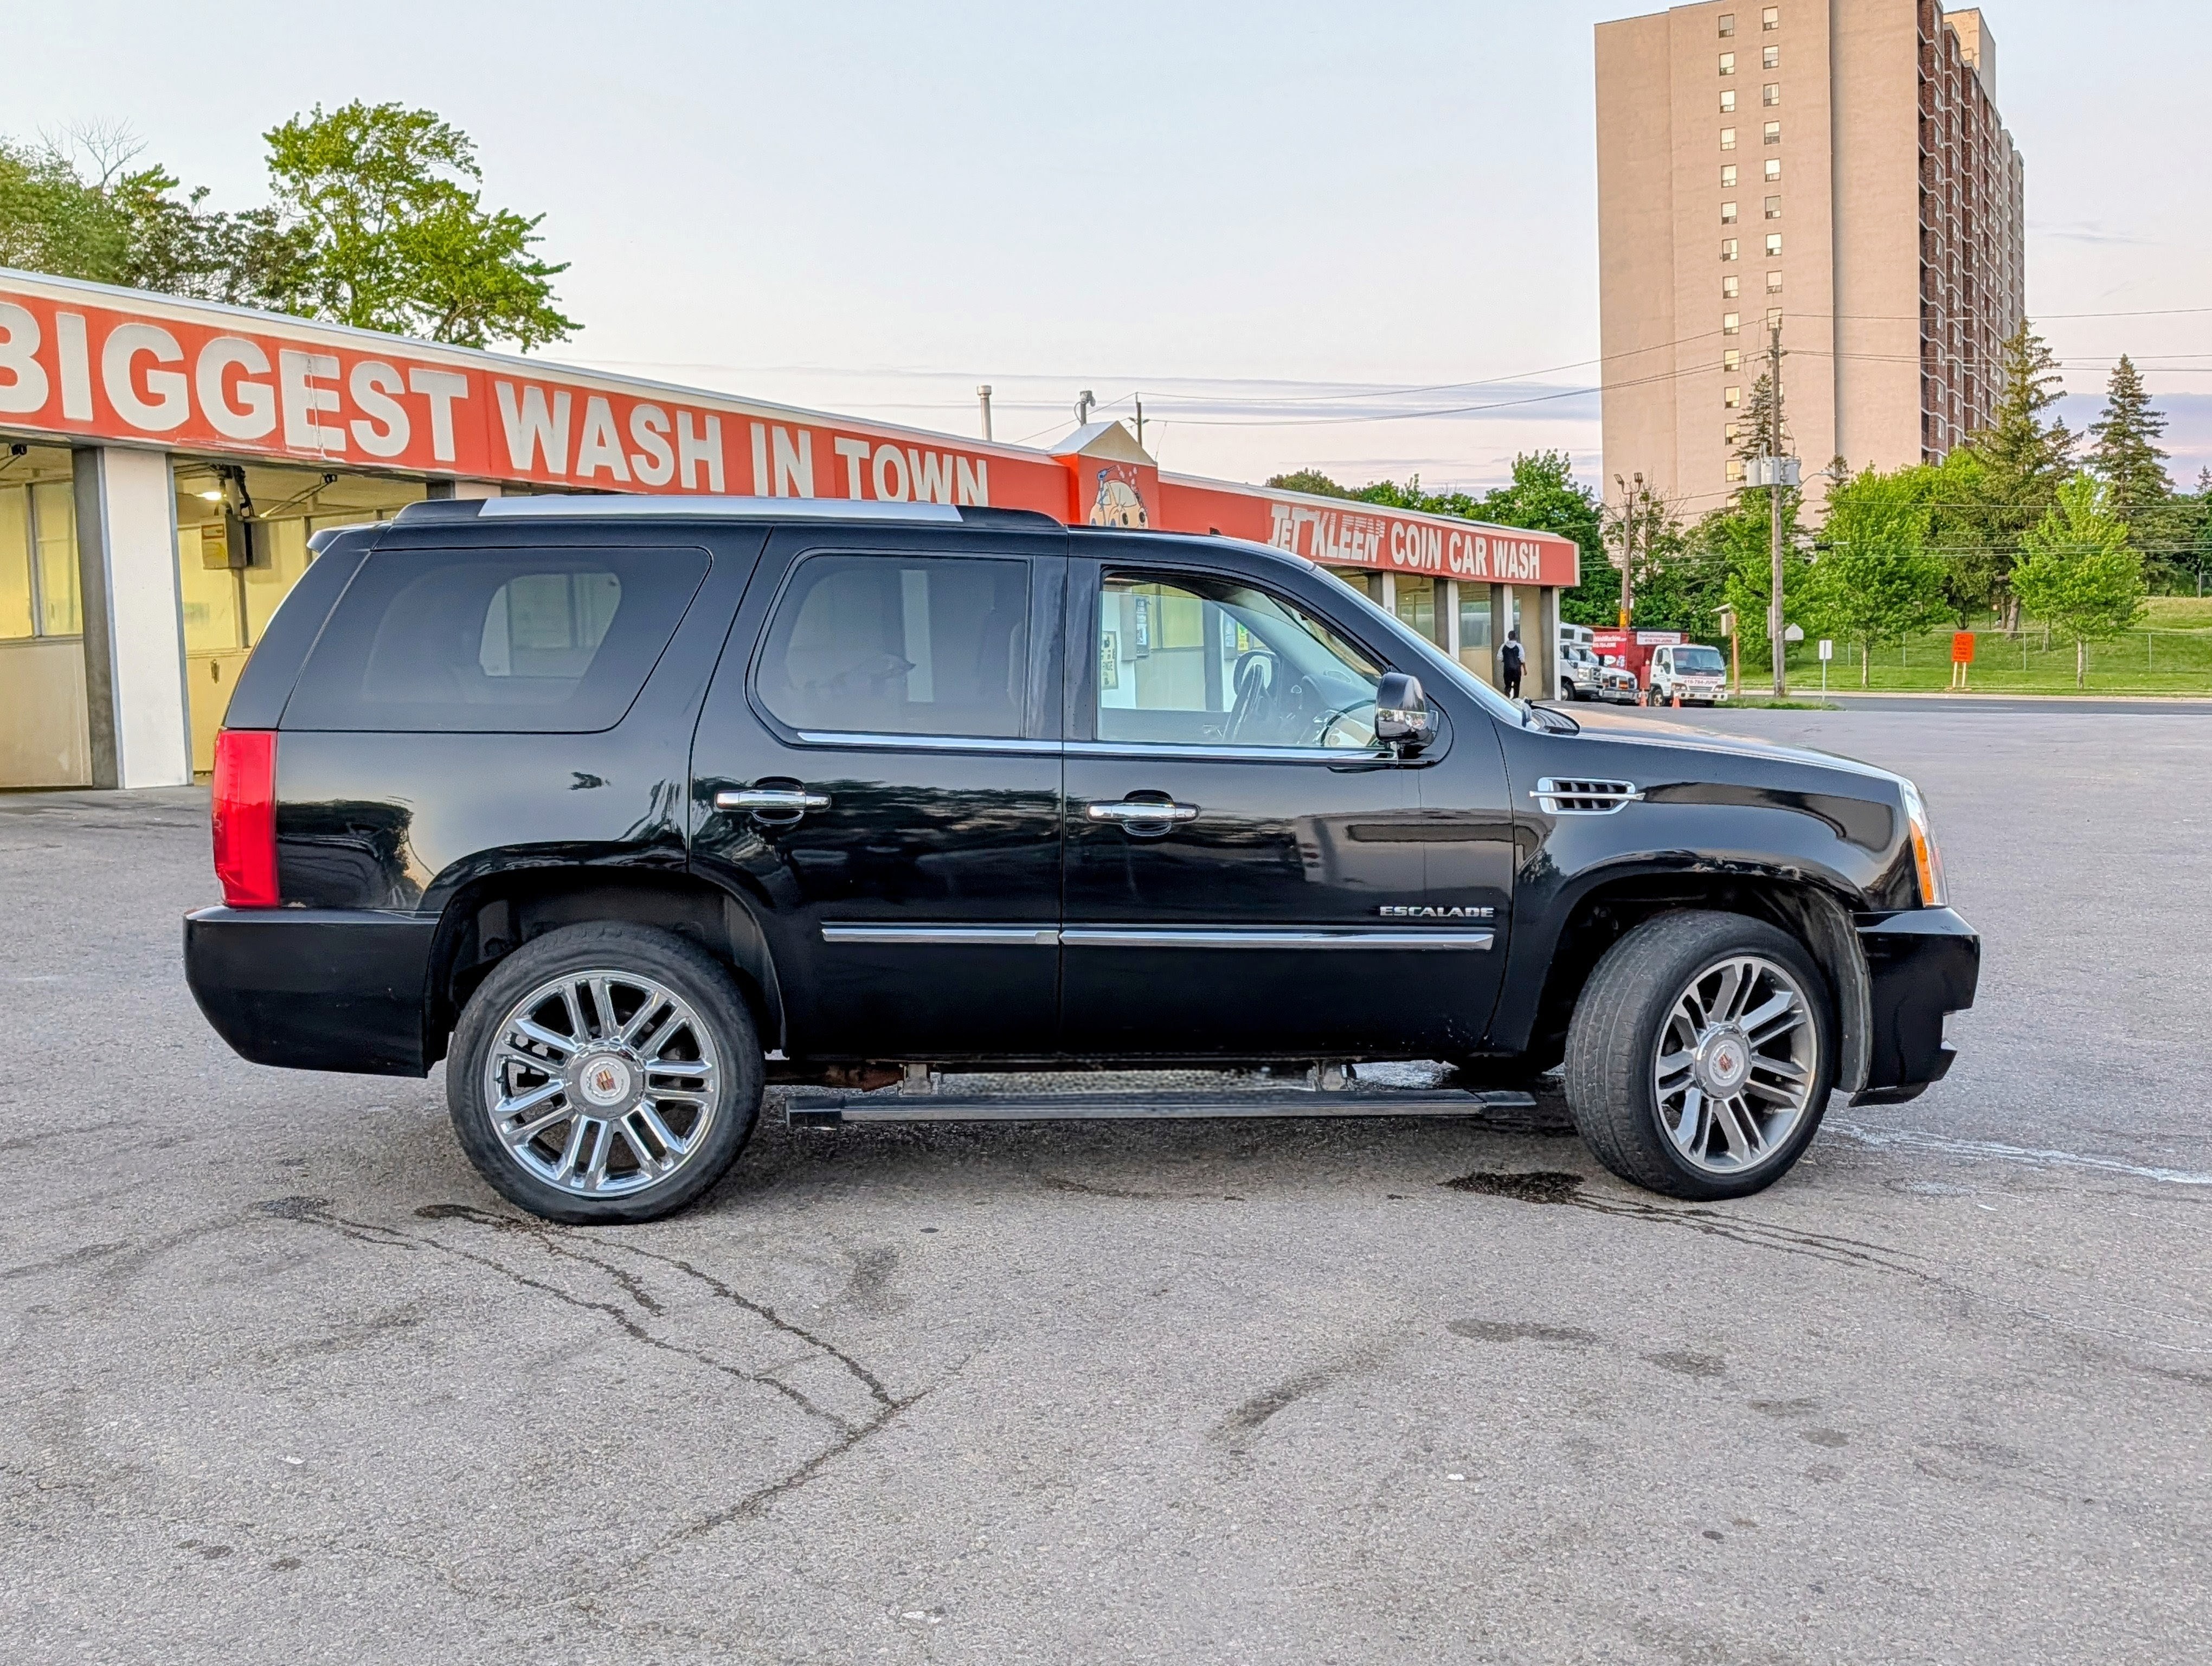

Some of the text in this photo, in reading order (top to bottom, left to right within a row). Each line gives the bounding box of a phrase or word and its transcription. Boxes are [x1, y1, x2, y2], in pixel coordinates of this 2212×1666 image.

[0, 302, 989, 507] BIGGEST WASH IN TOWN
[1310, 510, 1386, 562] KLEEN
[1391, 521, 1442, 570] COIN
[1449, 531, 1487, 576] CAR
[1492, 539, 1540, 580] WASH
[1379, 906, 1494, 918] ESCALADE
